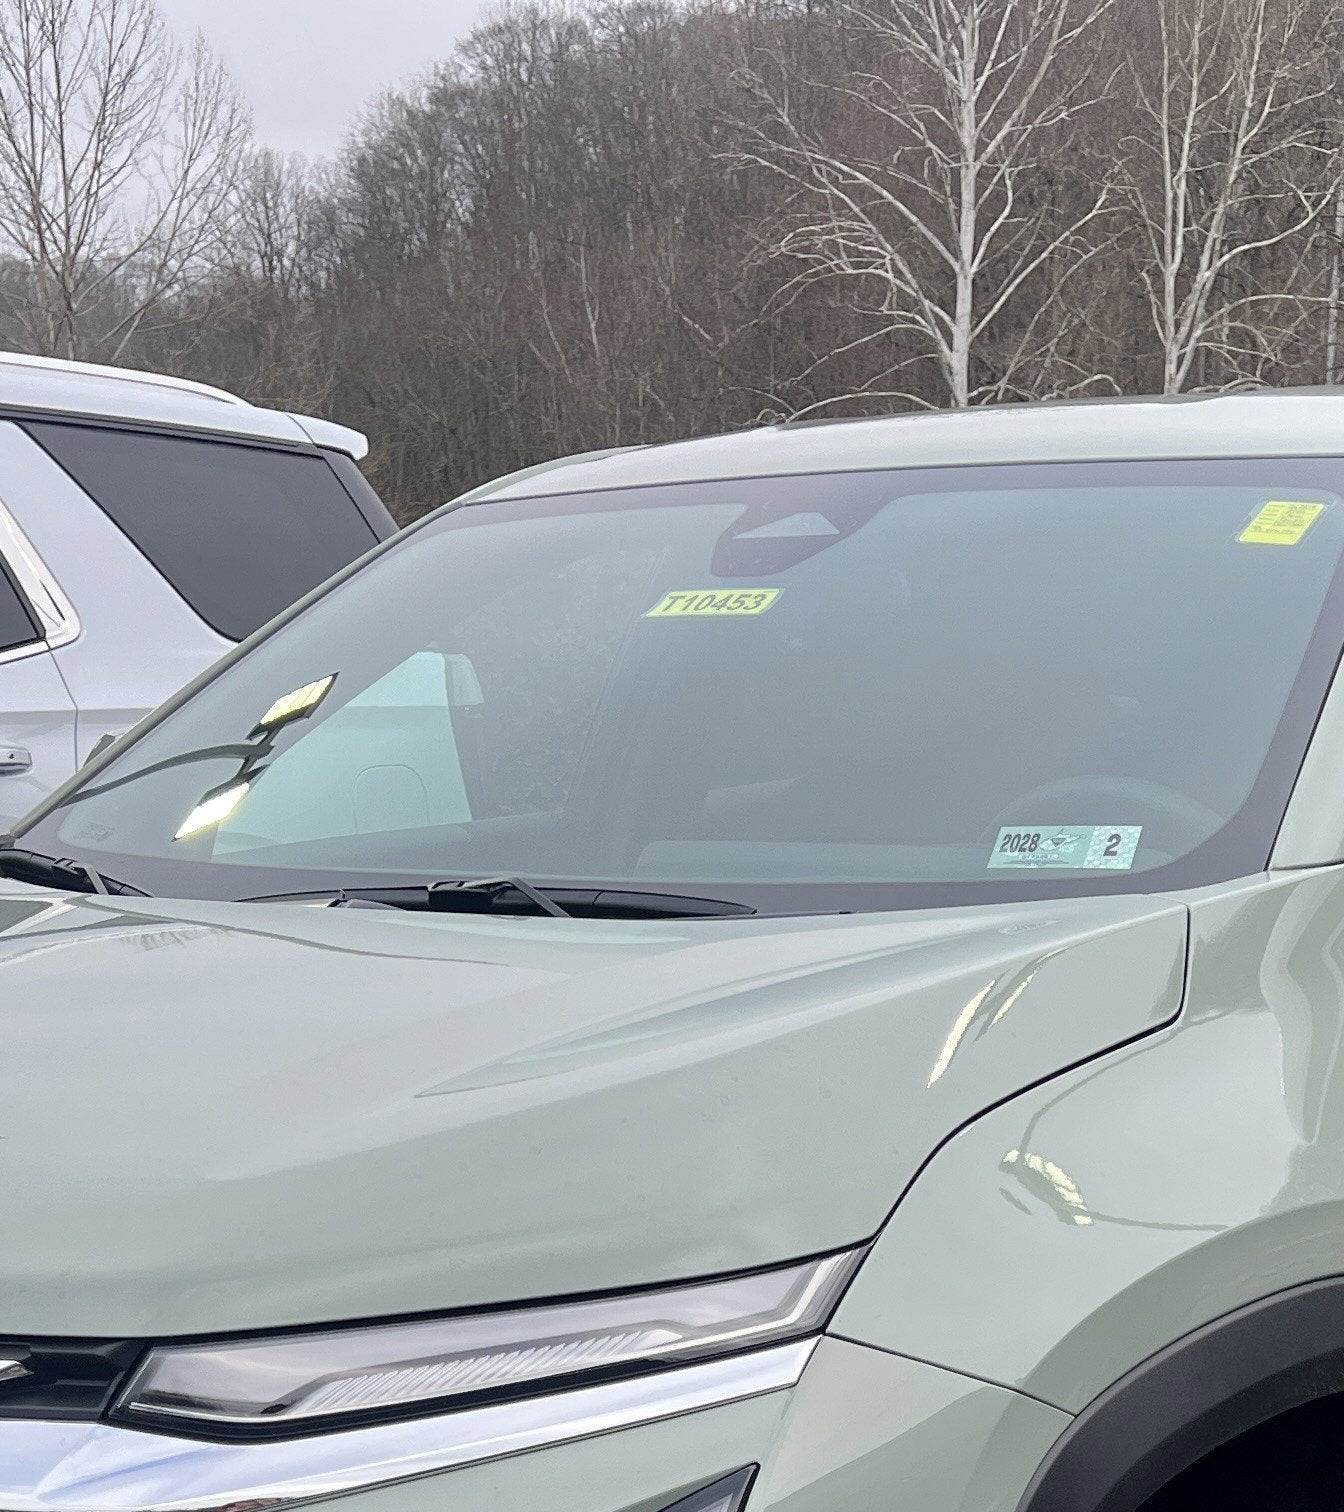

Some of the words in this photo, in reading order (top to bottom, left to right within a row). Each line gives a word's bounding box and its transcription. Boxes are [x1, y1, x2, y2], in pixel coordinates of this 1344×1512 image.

[661, 592, 767, 613] T10453
[999, 832, 1041, 854] 2028
[1102, 833, 1122, 857] 2
